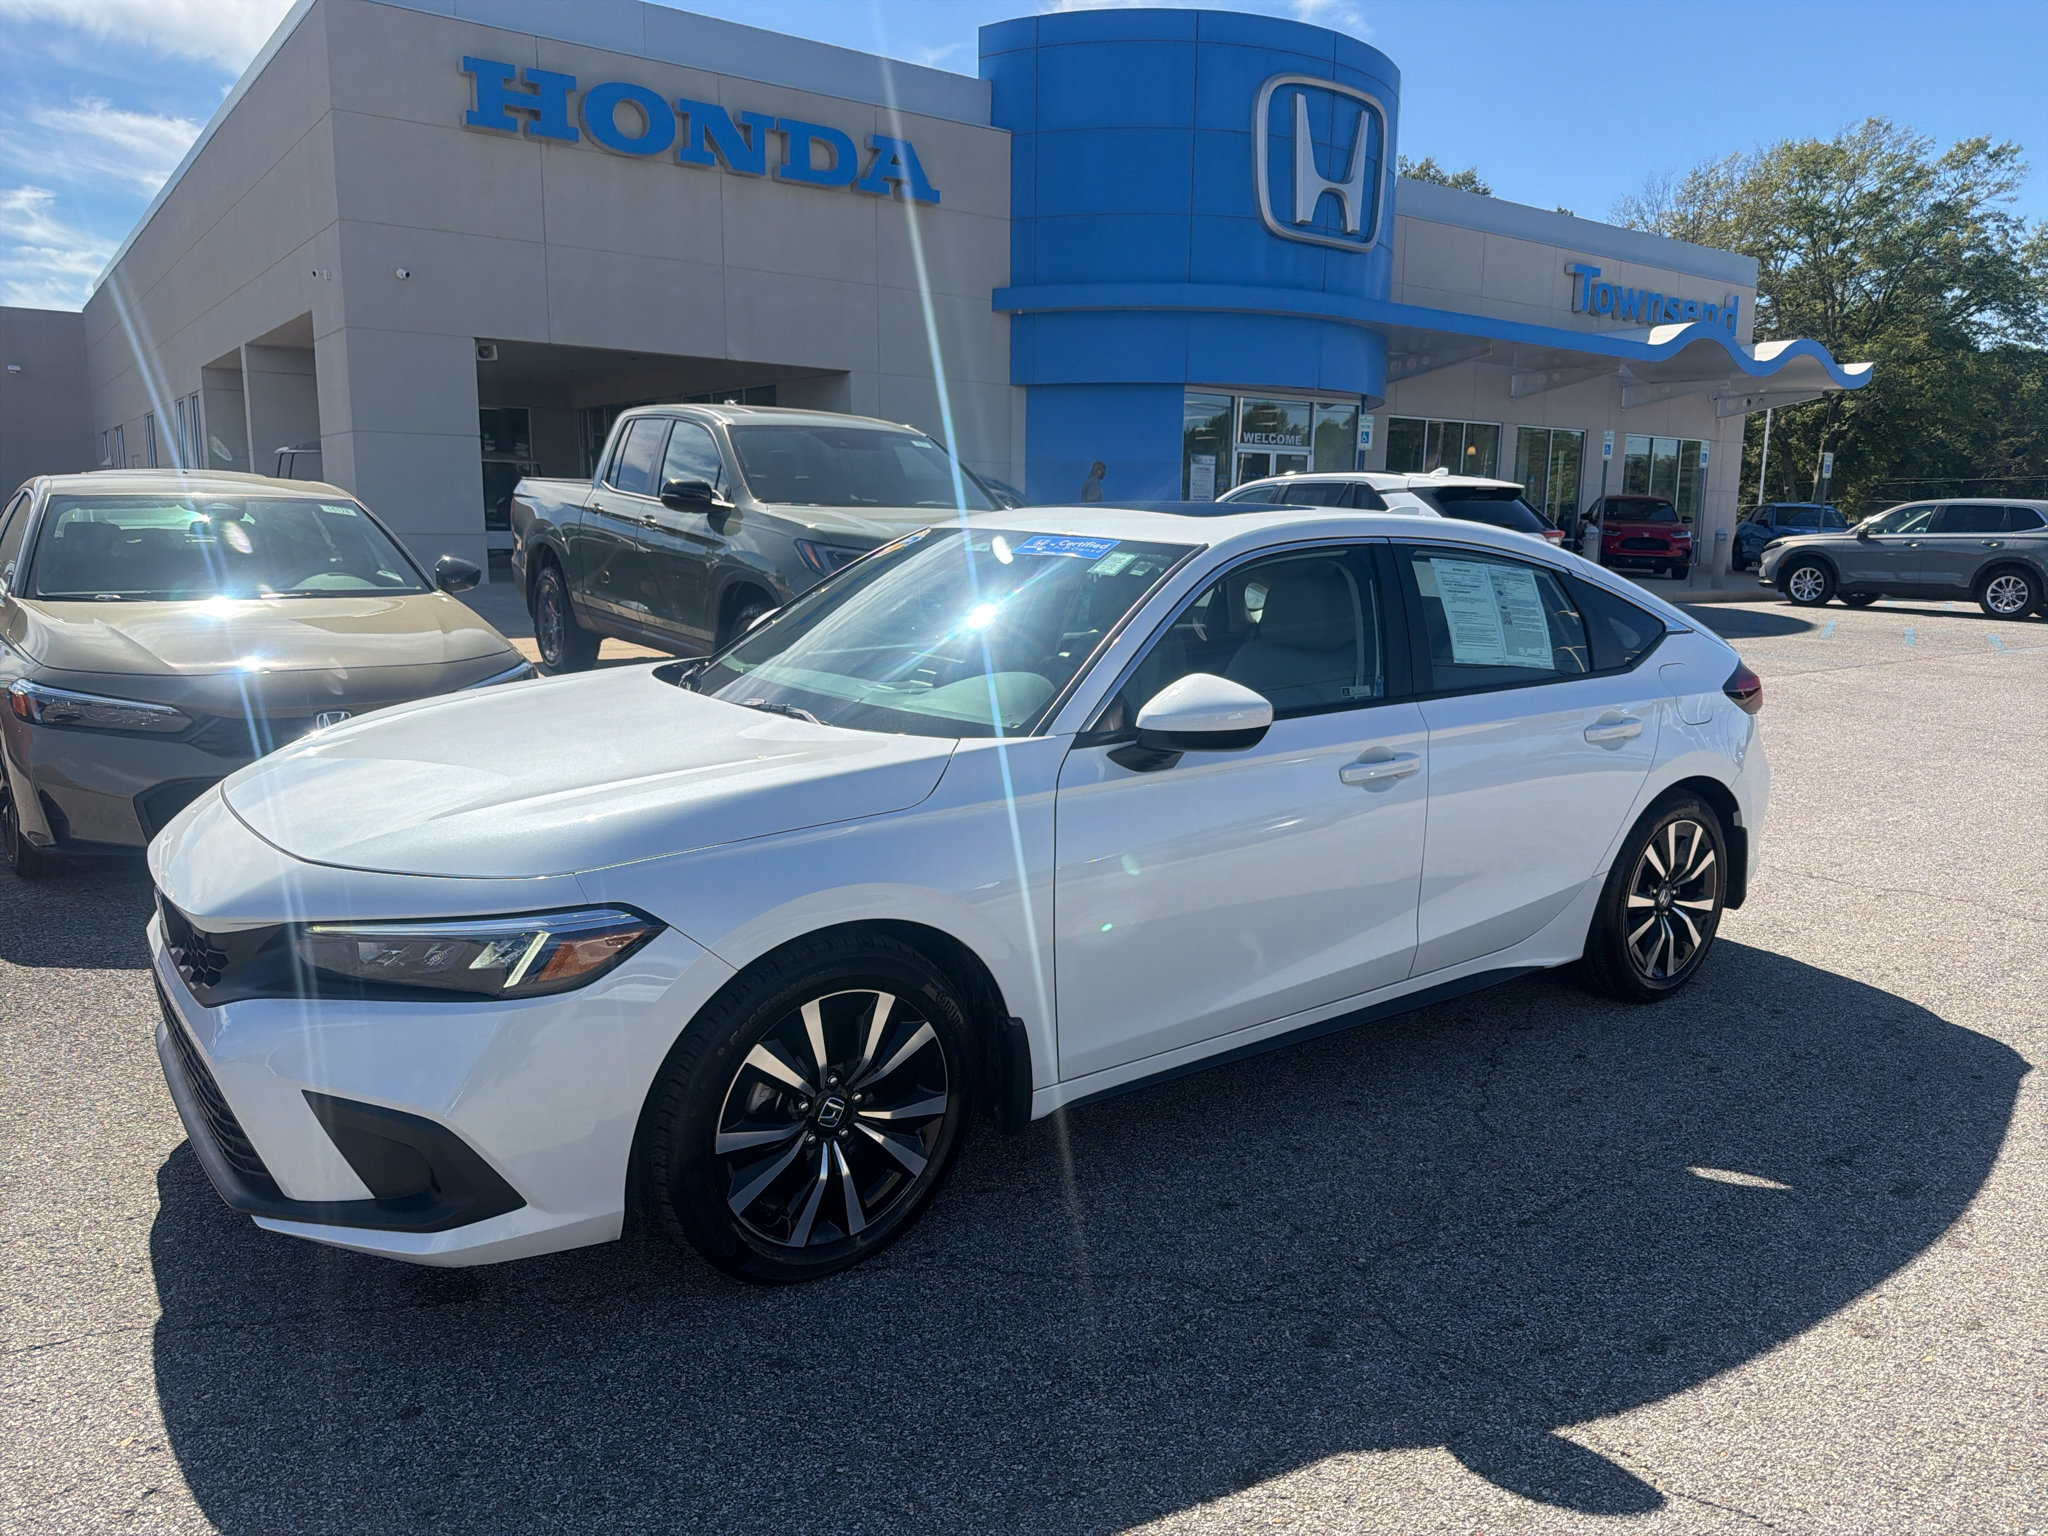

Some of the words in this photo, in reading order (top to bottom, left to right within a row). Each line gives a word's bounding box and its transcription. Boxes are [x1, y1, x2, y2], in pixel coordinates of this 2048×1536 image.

[459, 56, 941, 205] HONDA
[1565, 263, 1740, 337] Townsend
[1243, 431, 1302, 445] WELCOME
[1058, 539, 1111, 551] Certified
